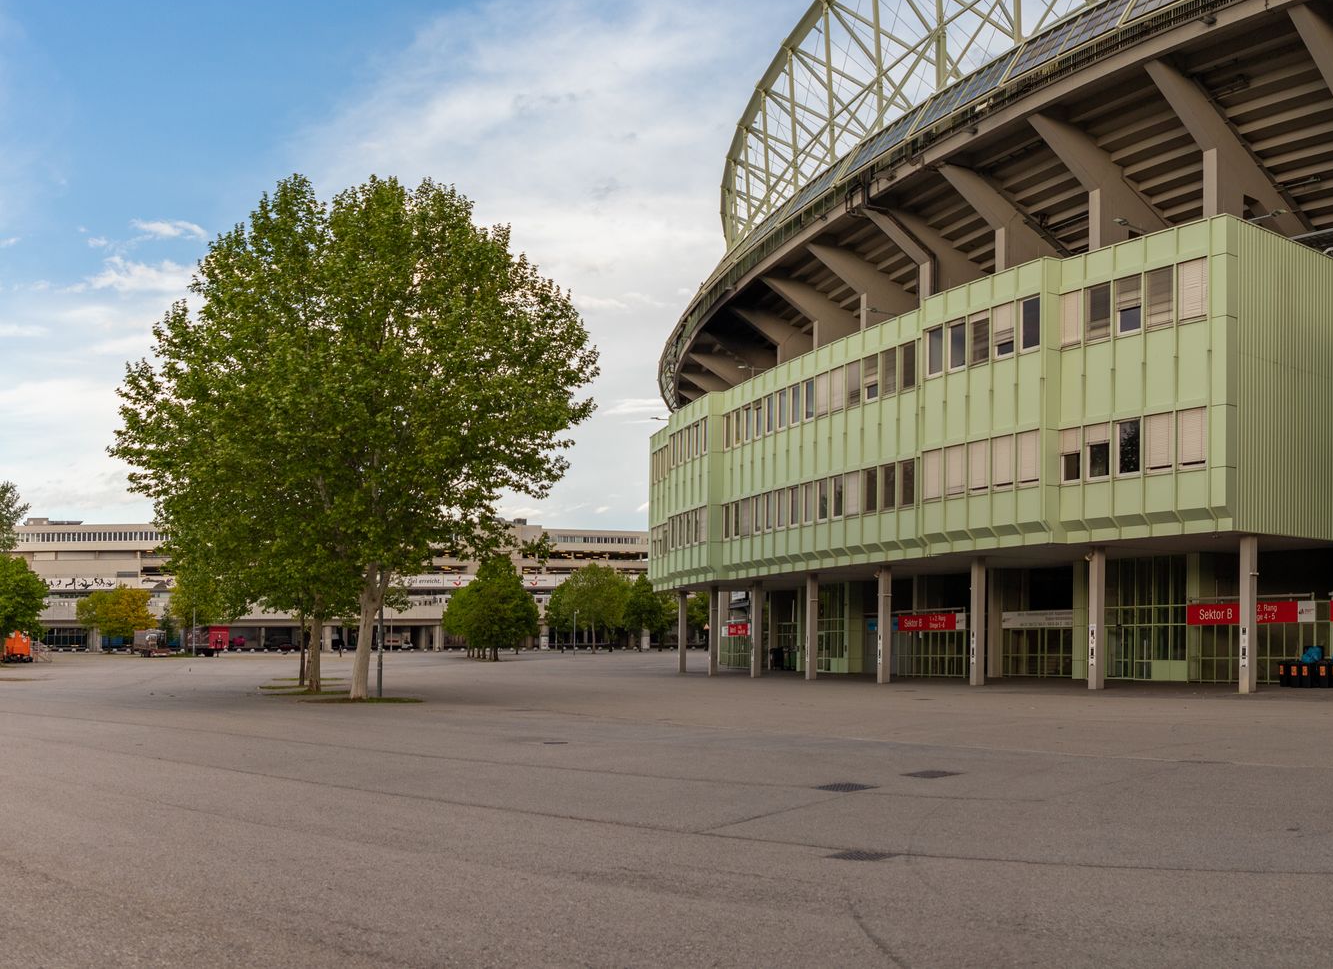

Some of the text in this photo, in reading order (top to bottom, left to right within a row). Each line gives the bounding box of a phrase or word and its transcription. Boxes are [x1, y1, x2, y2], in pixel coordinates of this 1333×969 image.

[1263, 603, 1278, 613] Rang
[1199, 608, 1233, 620] Sektor B
[904, 618, 923, 628] Sektor B
